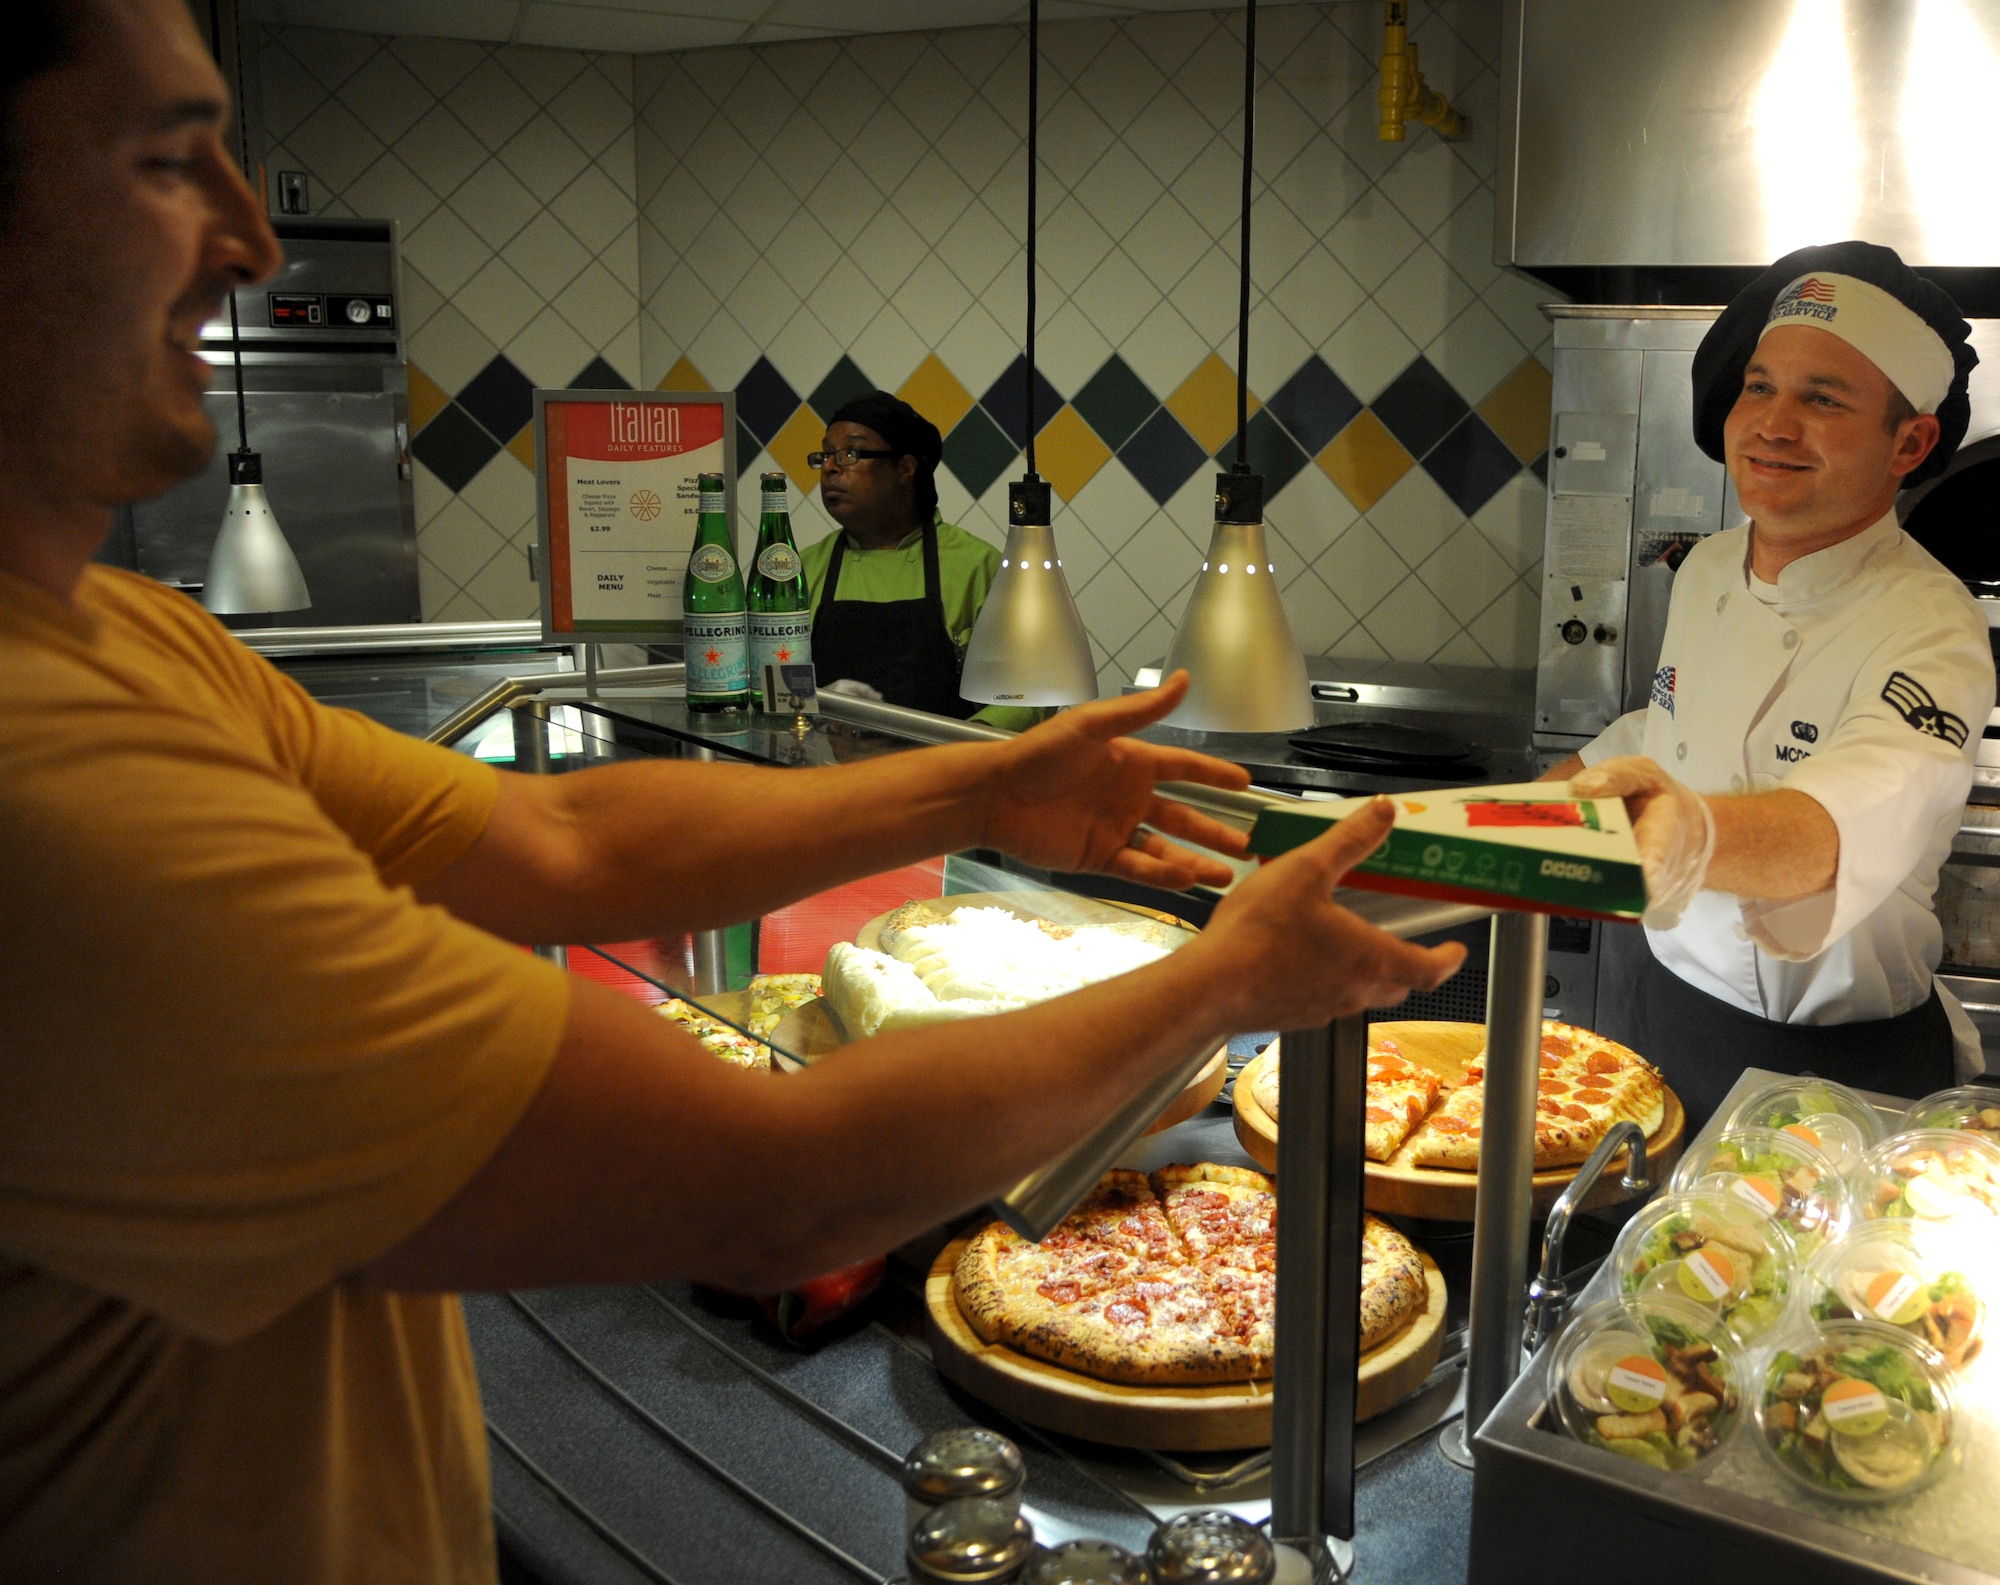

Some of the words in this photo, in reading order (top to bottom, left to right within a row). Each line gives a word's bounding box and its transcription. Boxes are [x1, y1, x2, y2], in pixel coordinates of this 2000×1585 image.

[1781, 307, 1835, 322] SERVICE
[610, 401, 680, 443] Italian
[607, 444, 634, 453] DAILY
[637, 444, 684, 453] FEATURES
